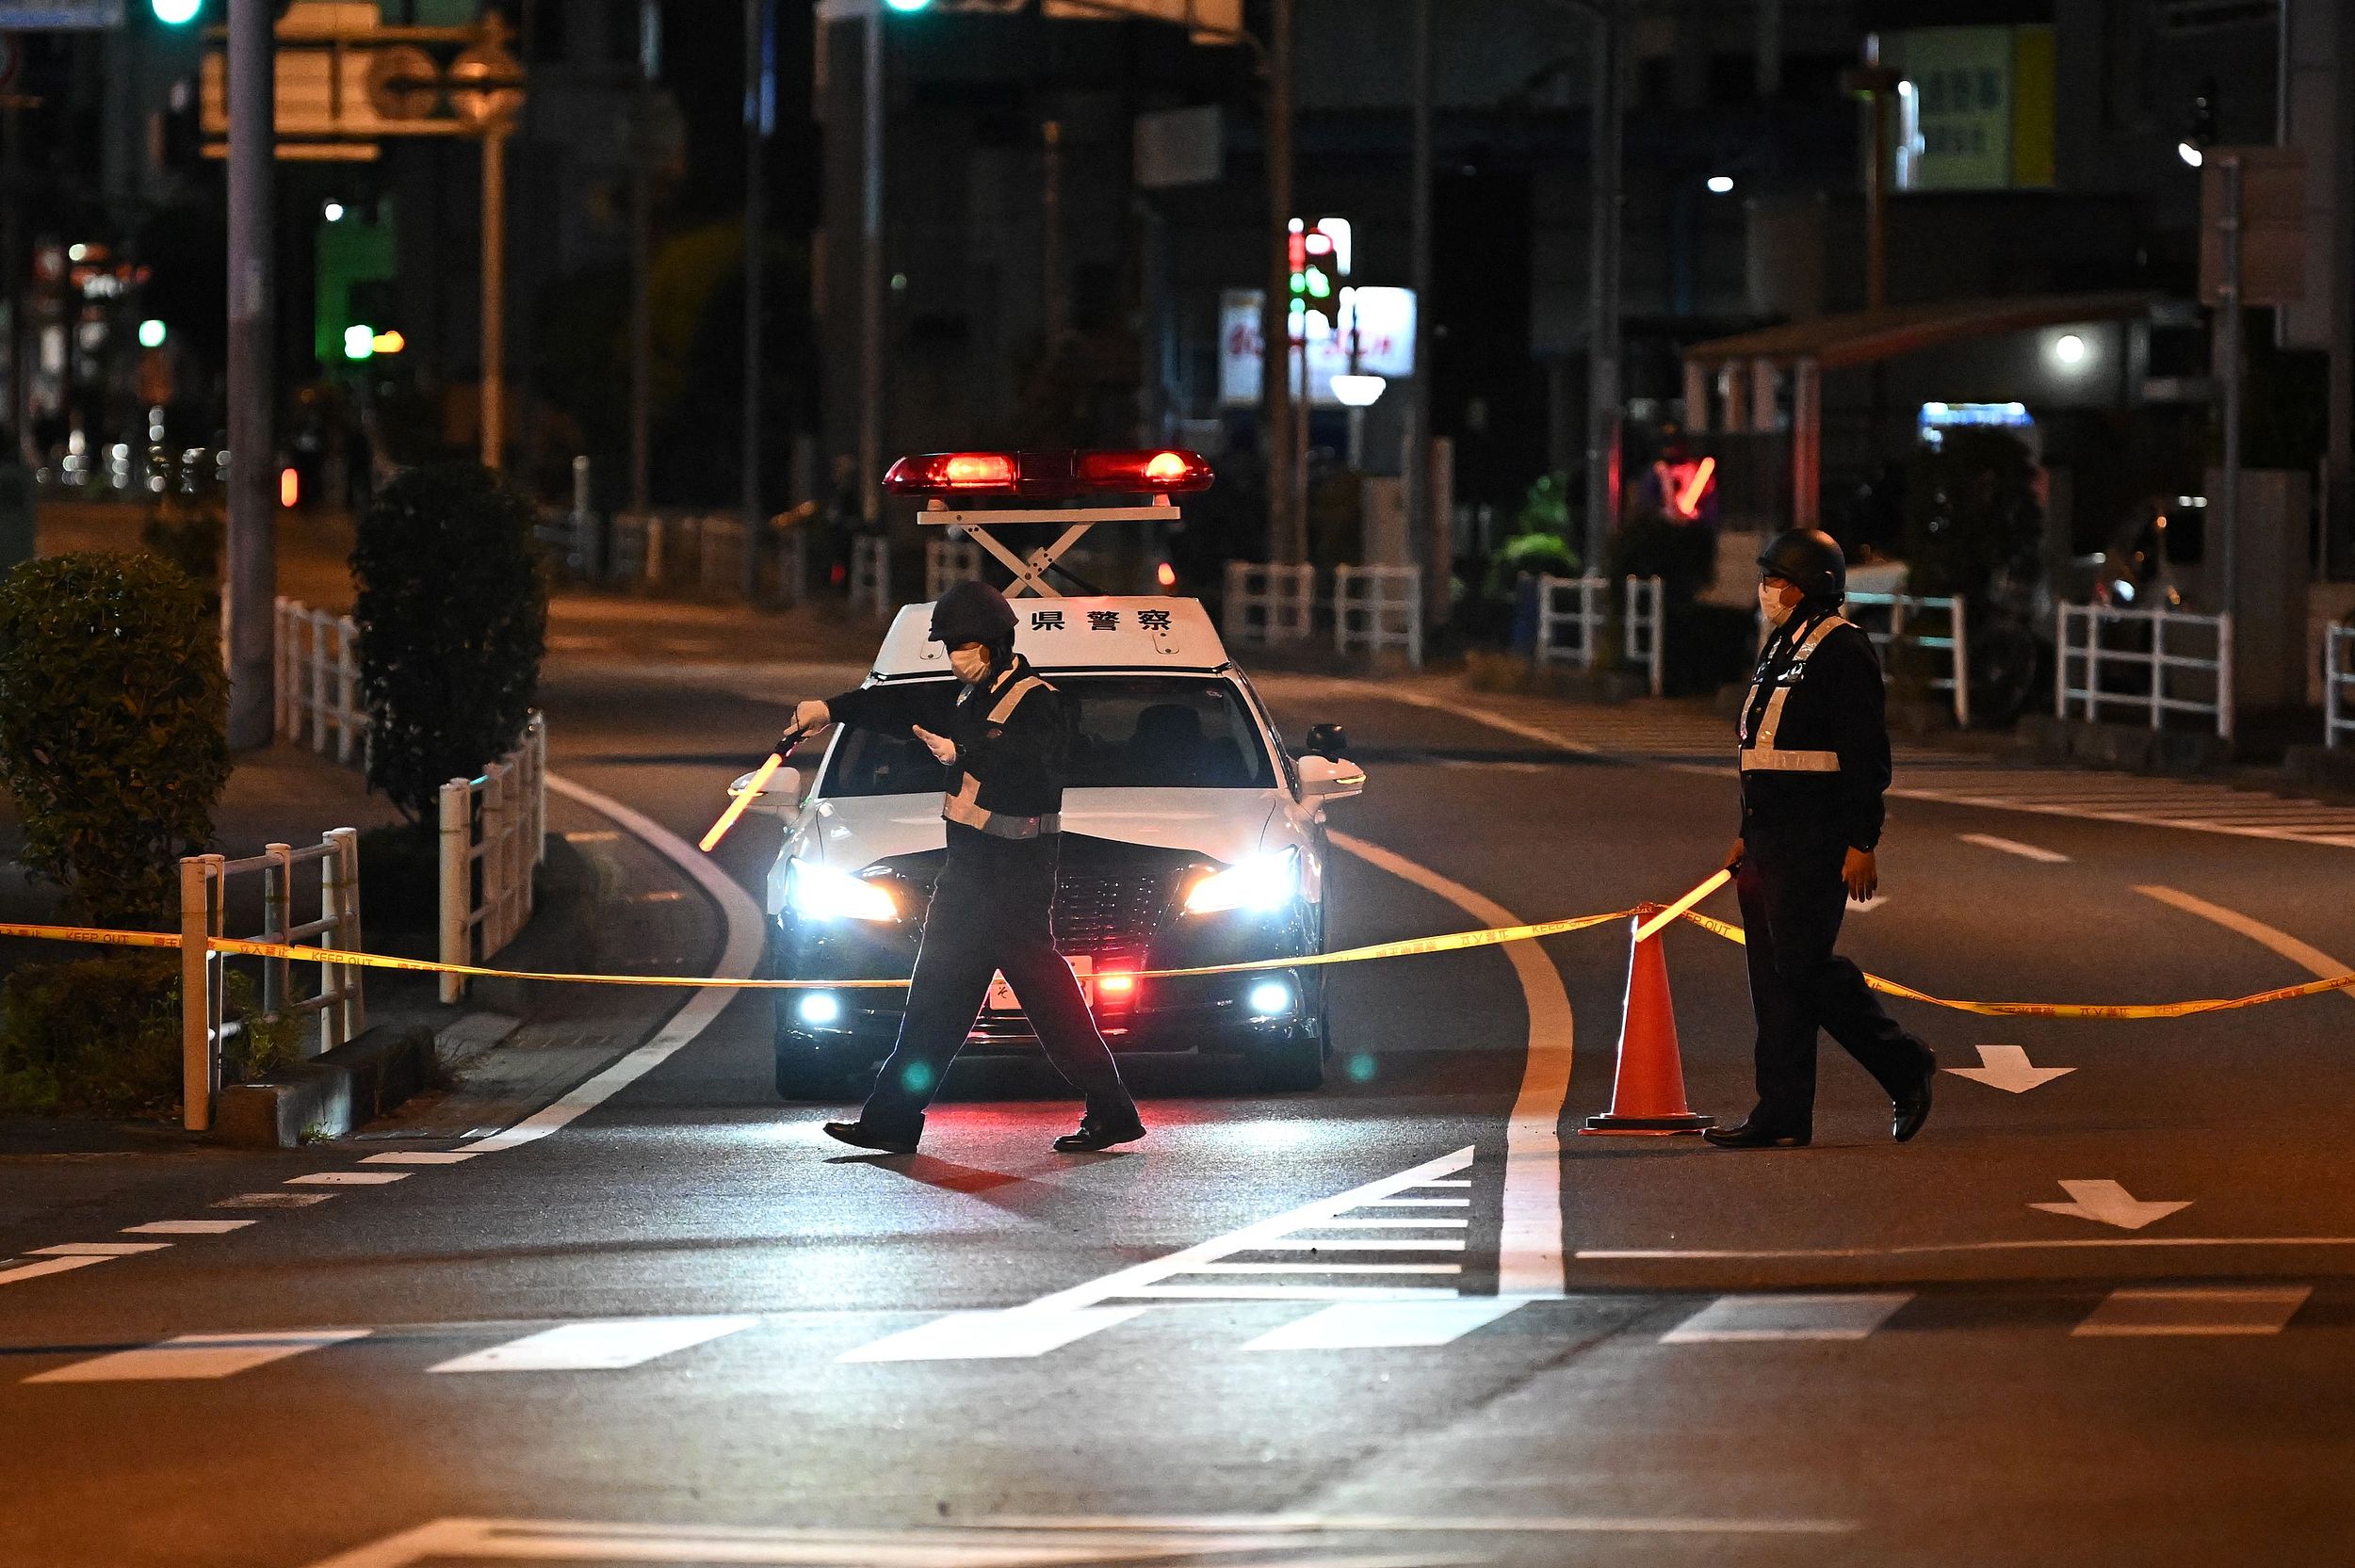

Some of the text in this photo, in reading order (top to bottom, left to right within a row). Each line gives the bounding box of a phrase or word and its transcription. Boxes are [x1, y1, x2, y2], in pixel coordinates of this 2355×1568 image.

[1031, 609, 1172, 631] 県警察
[1705, 920, 1731, 935] OUT
[66, 930, 129, 945] KEEP OUT
[311, 951, 374, 966] KEEP OUT
